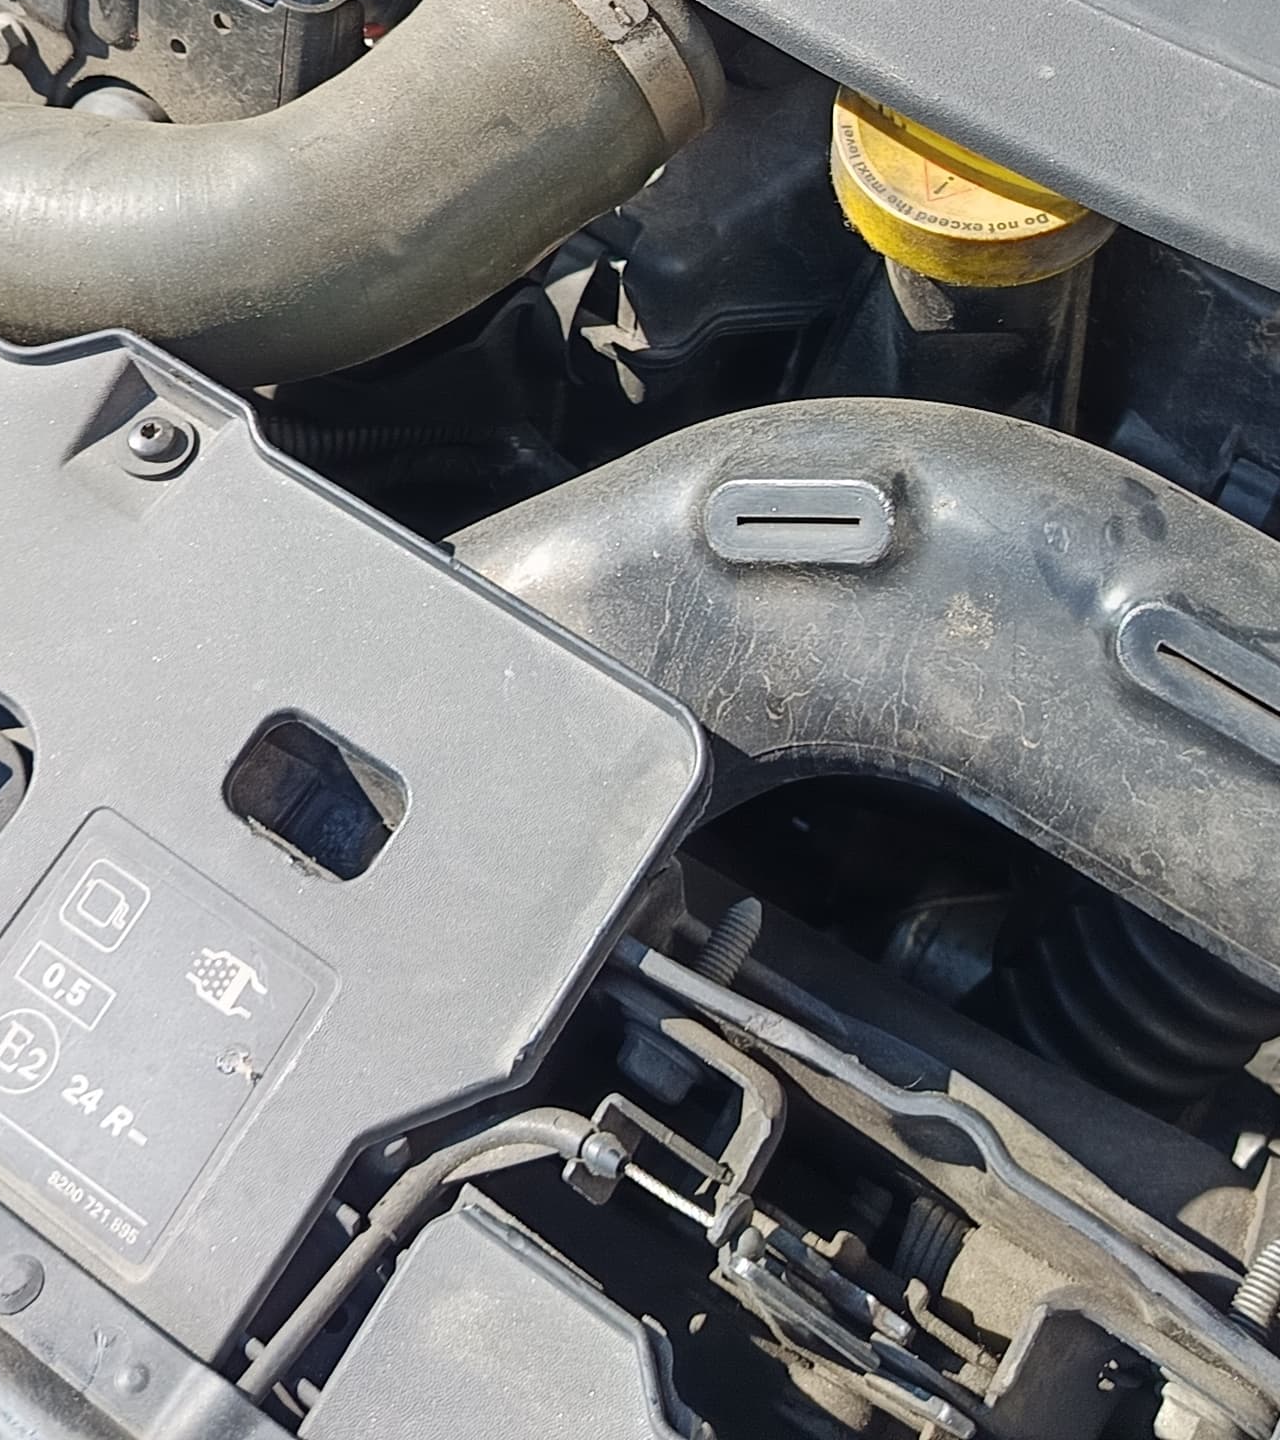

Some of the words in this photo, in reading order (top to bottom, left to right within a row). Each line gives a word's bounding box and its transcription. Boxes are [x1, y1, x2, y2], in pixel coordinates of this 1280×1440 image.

[841, 124, 861, 160] level
[853, 162, 887, 194] maxi
[887, 195, 914, 216] the
[915, 211, 984, 231] exceed
[1024, 213, 1050, 226] Do
[988, 219, 1019, 233] not
[42, 962, 92, 1007] 0,5
[61, 1074, 104, 1115] 24
[47, 1170, 84, 1203] 8200
